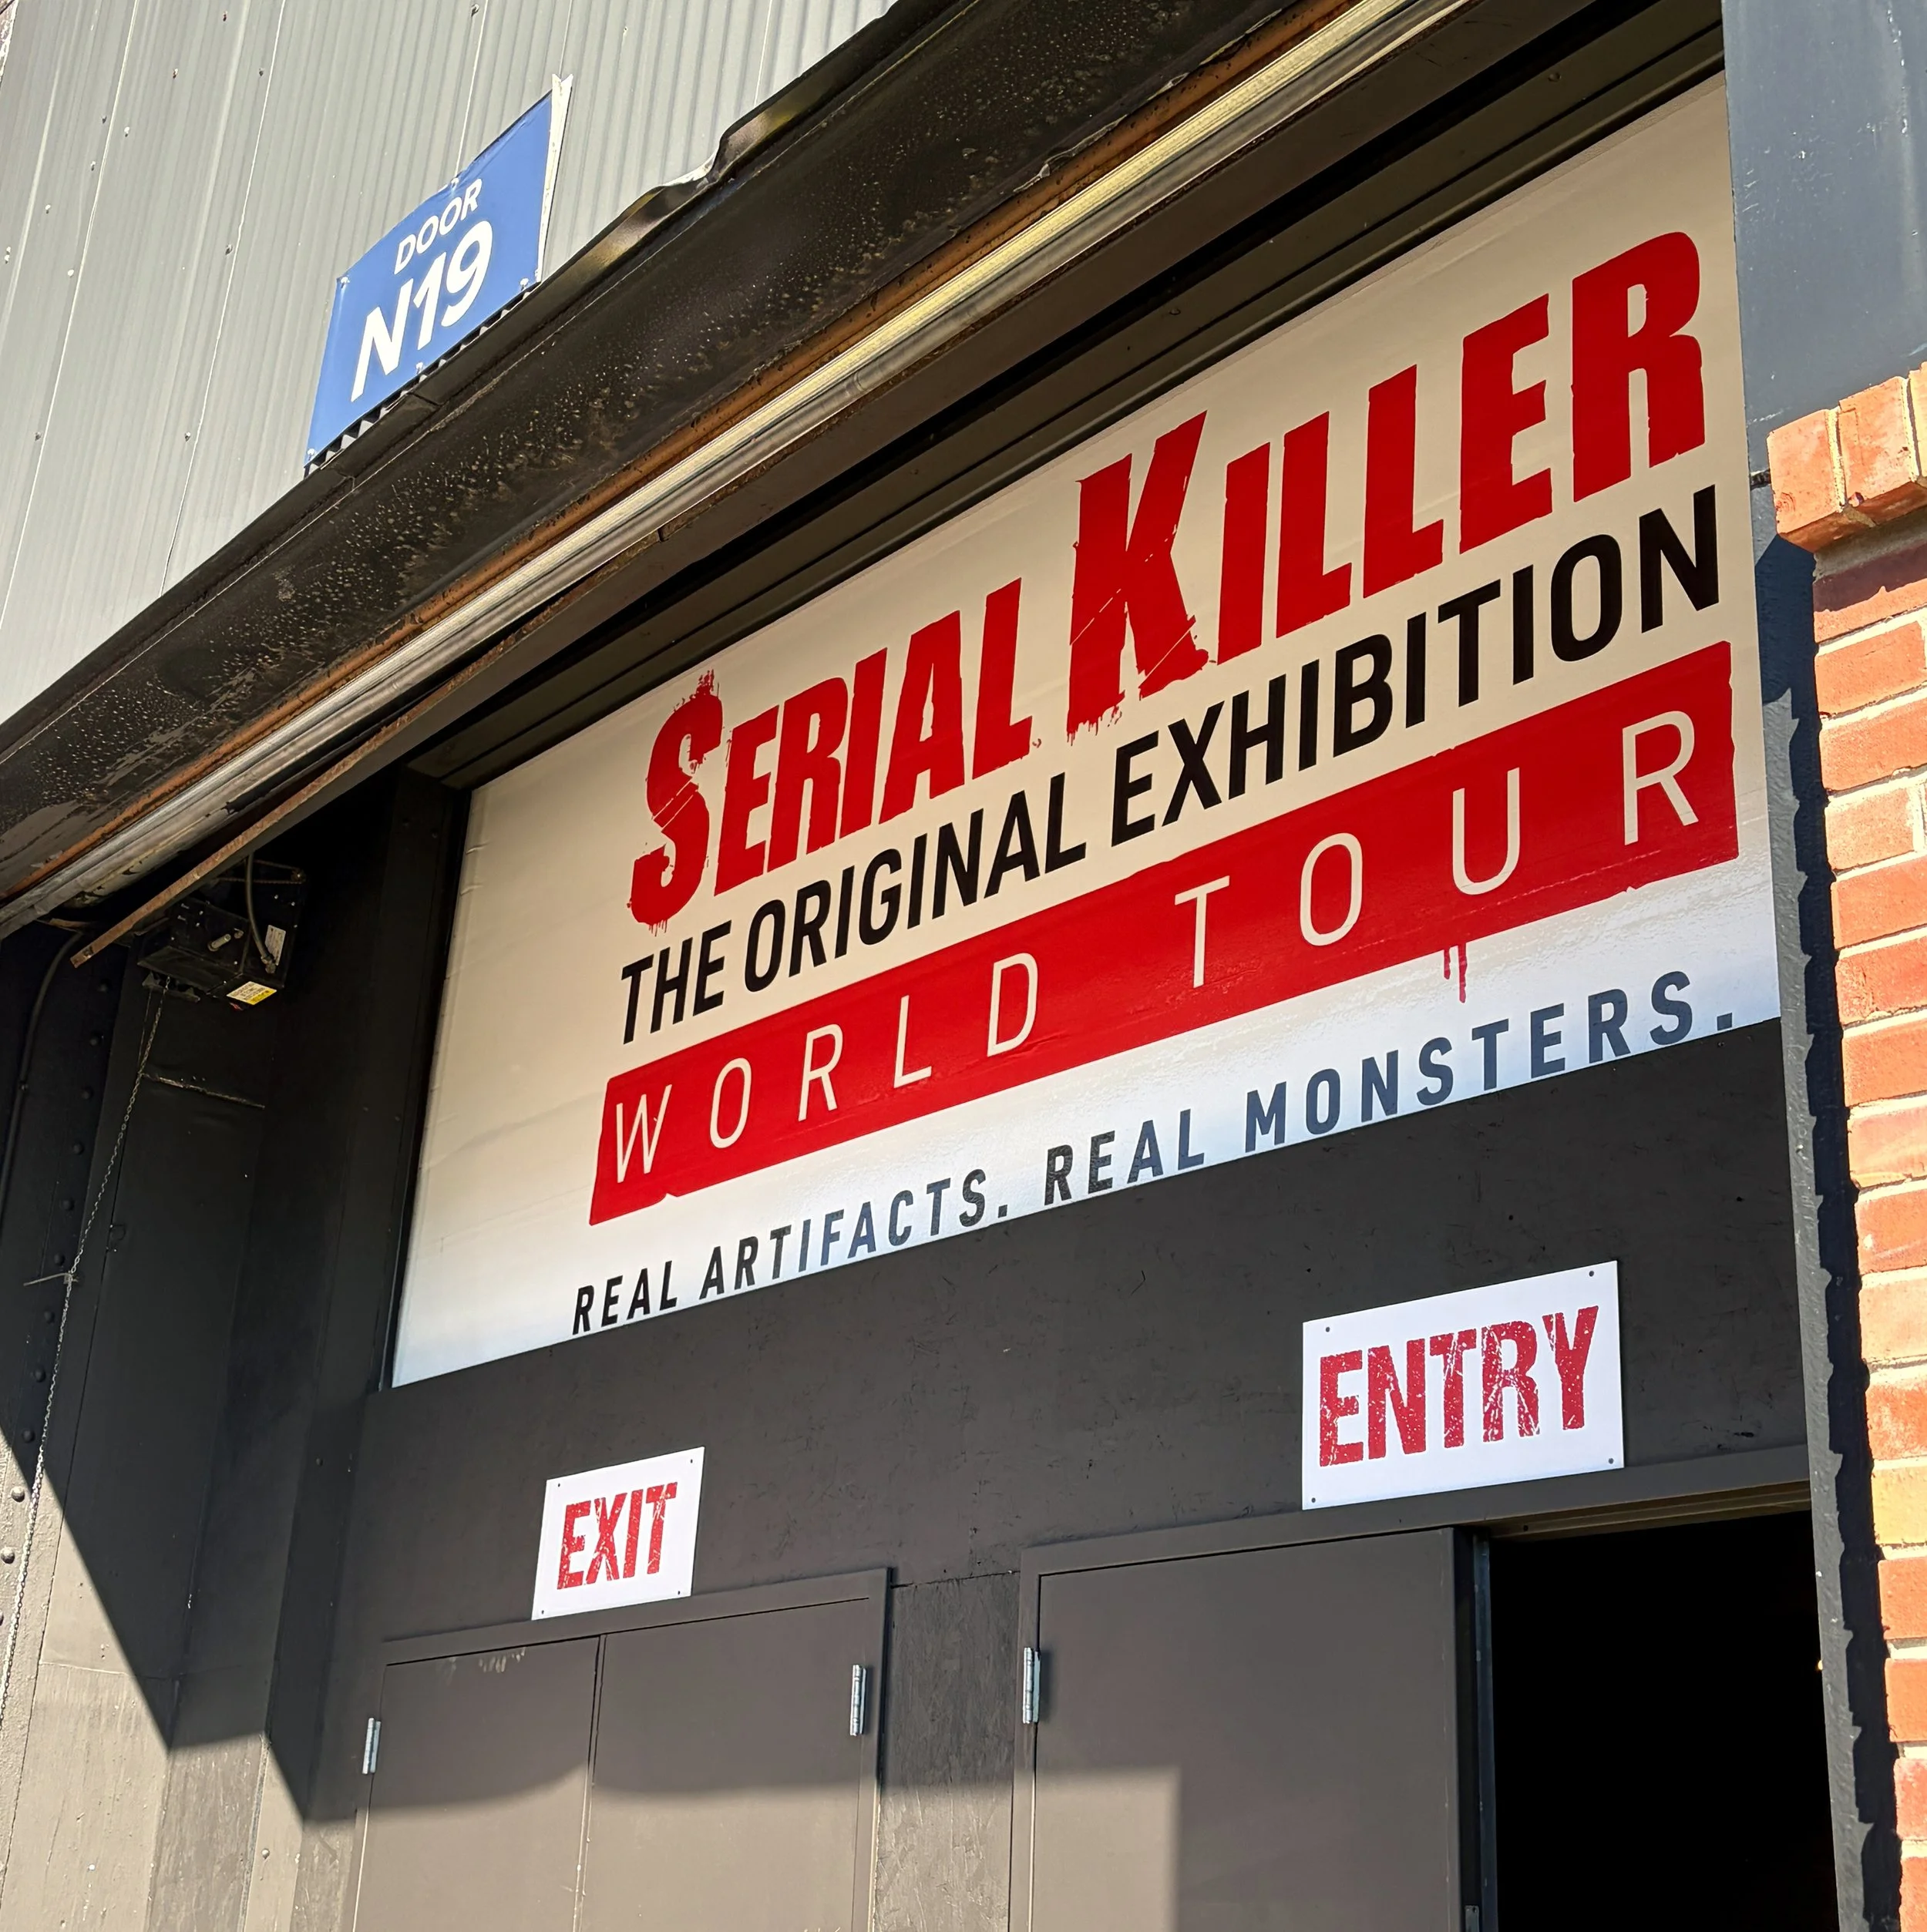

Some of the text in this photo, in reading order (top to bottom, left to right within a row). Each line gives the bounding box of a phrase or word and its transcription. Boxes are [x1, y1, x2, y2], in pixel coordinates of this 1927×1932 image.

[351, 220, 493, 402] N19
[394, 179, 483, 274] DOOR
[627, 231, 1706, 934] SERIAL KILLER
[621, 485, 1720, 1044] THE ORIGINAL EXHIBITION
[617, 711, 1699, 1183] WORLD TOUR
[572, 971, 1733, 1335] REAL ARTIFACTS. REAL MONSTERS.
[1319, 1305, 1599, 1467] ENTRY
[557, 1482, 677, 1590] EXIT
